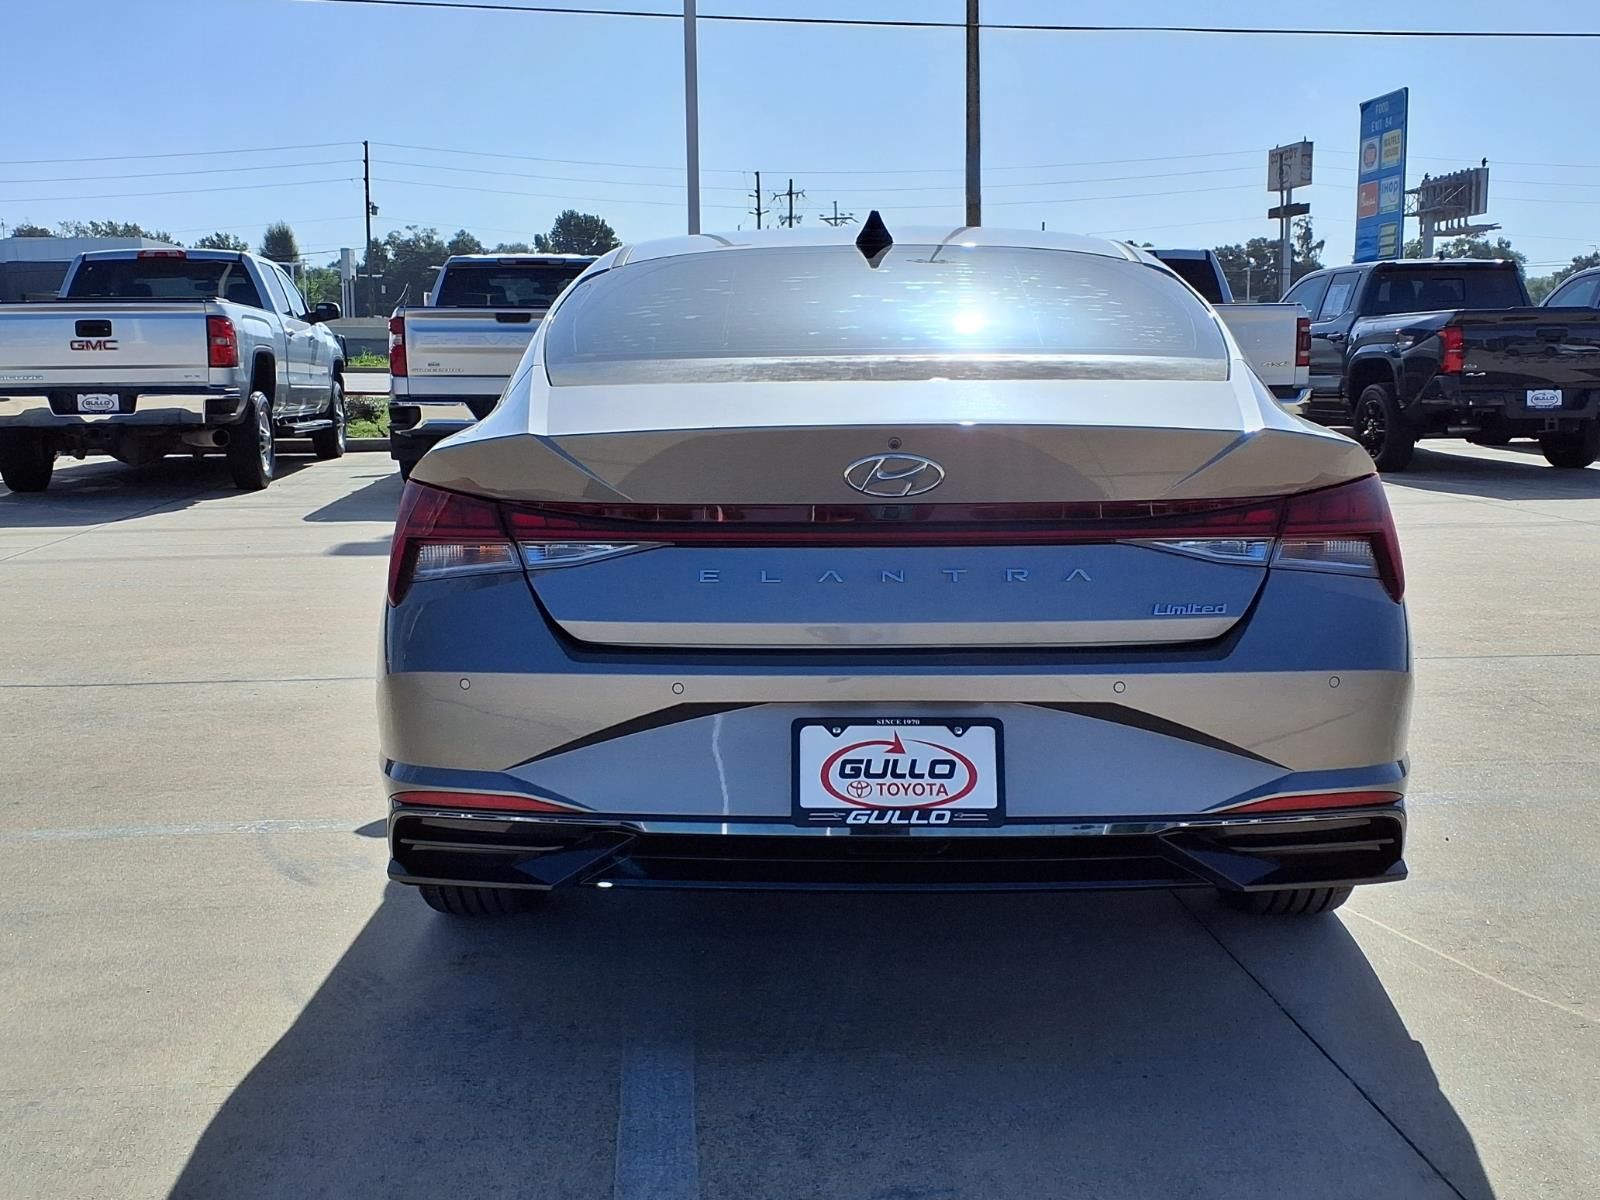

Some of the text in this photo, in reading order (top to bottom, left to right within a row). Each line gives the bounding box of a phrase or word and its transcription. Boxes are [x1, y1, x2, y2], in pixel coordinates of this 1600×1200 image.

[70, 340, 119, 350] GMC
[699, 568, 1092, 584] ELANTRA
[1153, 603, 1227, 615] Limited
[838, 759, 957, 779] GULLO
[876, 783, 949, 796] TOYOTA
[846, 810, 951, 824] GULLO
